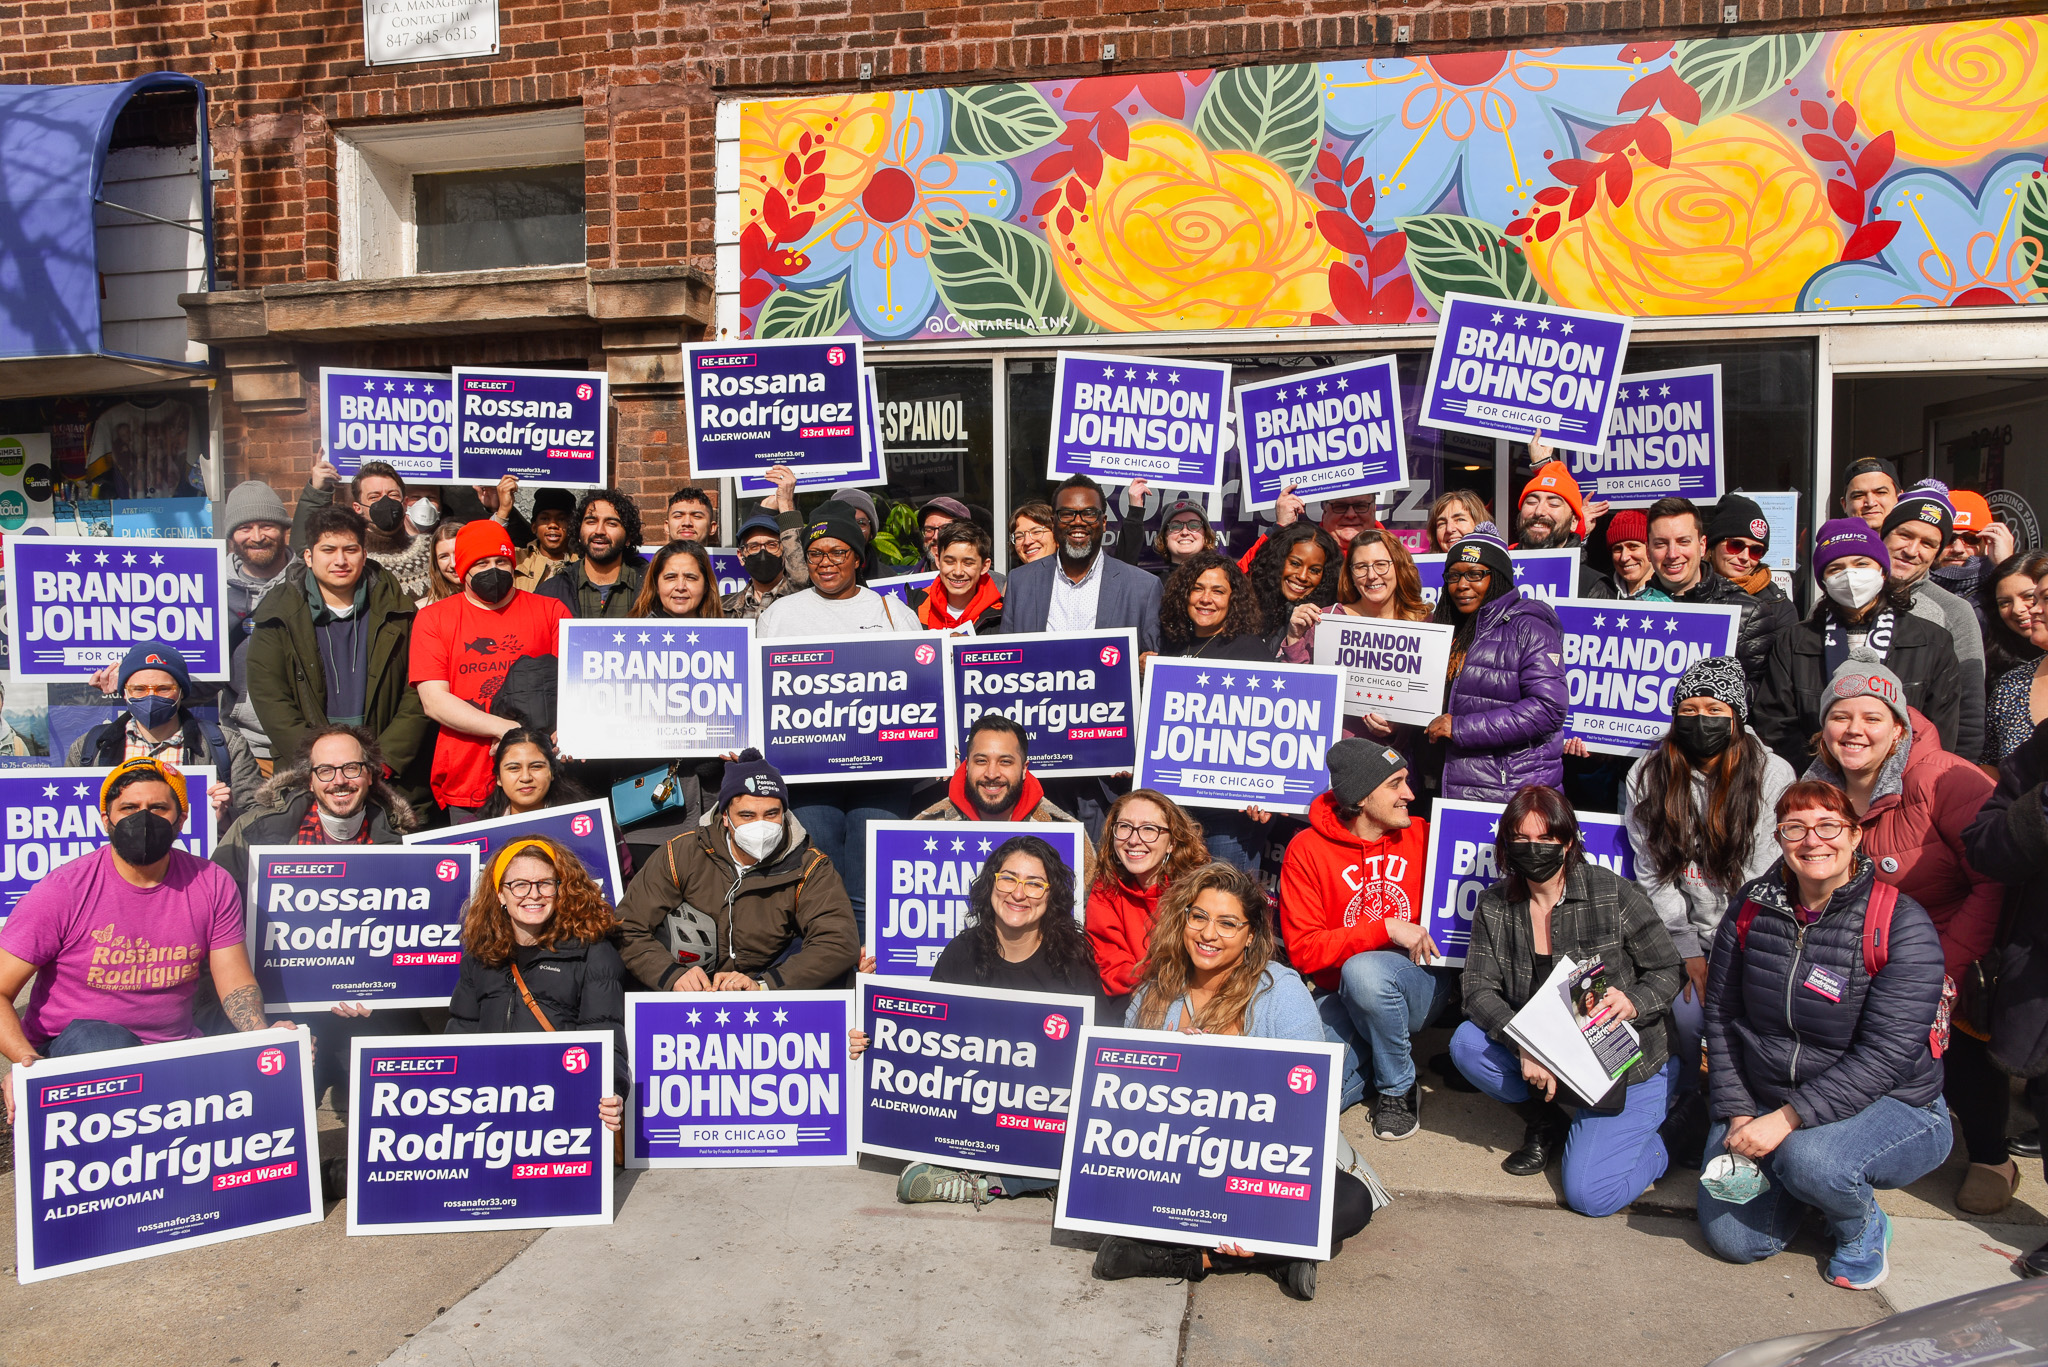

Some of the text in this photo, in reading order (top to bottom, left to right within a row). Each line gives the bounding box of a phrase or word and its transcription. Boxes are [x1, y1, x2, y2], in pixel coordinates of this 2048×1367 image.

[372, 2, 402, 14] L.C.A.
[392, 12, 470, 28] CONTACT JIM
[386, 26, 477, 48] 847-845-6315
[829, 352, 844, 364] 51
[1456, 326, 1605, 376] BRANDON
[702, 357, 748, 366] RE-ELECT
[467, 382, 507, 390] RE-ELECT
[577, 388, 591, 399] 51
[701, 372, 826, 397] Rossana
[1440, 358, 1605, 413] JOHNSON
[465, 394, 573, 419] Rossana
[1074, 382, 1210, 420] BRANDON
[701, 399, 852, 431] Rodríguez
[1255, 390, 1382, 439] BRANDON
[1477, 405, 1551, 425] FOR CHICAGO
[1608, 401, 1702, 435] ANDON
[334, 422, 452, 453] JOHNSO
[463, 422, 594, 451] Rodríguez
[702, 431, 770, 442] ALDERWOMAN
[802, 427, 850, 437] 33rd Ward
[1063, 413, 1214, 454] JOHNSON
[464, 447, 522, 456] ALDERWOMAN
[549, 450, 569, 458] 33rd
[1253, 420, 1392, 474] JOHNSON
[1100, 456, 1170, 469] FOR CHICAGO
[1290, 468, 1354, 485] FOR CHICAGO
[1607, 479, 1671, 489] FOR CHICAGO
[1919, 514, 1940, 524] SEIU
[1986, 494, 2038, 548] WORKING FAMIL
[122, 527, 213, 538] PLANES GENIALES
[1830, 533, 1853, 542] SEIU
[34, 571, 204, 603] BRANDON
[26, 606, 213, 641] JOHNSON
[1340, 630, 1420, 653] BRANDON
[774, 653, 823, 662] RE-ELECT
[916, 651, 933, 664] 51
[965, 652, 1013, 662] RE-ELECT
[1101, 652, 1118, 665] 51
[1335, 648, 1422, 674] JOHNSON
[1563, 634, 1712, 672] BRANDON
[583, 650, 734, 680] BRANDON
[771, 670, 907, 696] Rossana
[964, 669, 1095, 695] Rossana
[1350, 675, 1402, 688] FOR CHICAGO
[1868, 676, 1897, 703] CTU
[1567, 670, 1676, 715] OHNSO
[770, 699, 936, 734] Rodríguez
[1163, 691, 1321, 731] BRANDON
[881, 729, 933, 740] 33rd Ward
[1071, 729, 1122, 738] 33rd Ward
[1584, 718, 1660, 736] FOR CHICAGO
[772, 733, 846, 744] ALDERWOMAN
[1150, 725, 1326, 771] JOHNSON
[828, 755, 883, 763] rossanafor33.org
[1026, 754, 1073, 762] ssanafor33.org
[1193, 774, 1274, 788] FOR CHICAGO
[574, 820, 592, 834] 51
[274, 864, 334, 874] RE-ELECT
[437, 866, 457, 880] 51
[892, 860, 984, 895] BRAN
[1342, 854, 1408, 891] CTU
[268, 883, 430, 912] Rossana
[1346, 896, 1360, 927] CHICAGO
[264, 918, 461, 956] Rodríguez
[92, 946, 187, 964] Rossana
[264, 956, 354, 968] ALDERWOMAN
[396, 953, 456, 964] 33rd Ward
[87, 982, 141, 990] ALDERWOMAN
[332, 980, 396, 990] rossanafor33.org
[878, 999, 936, 1015] RE-ELECT
[1052, 1015, 1067, 1024] PUNCH
[1045, 1020, 1067, 1038] 51
[653, 1032, 830, 1070] BRANDON
[874, 1017, 1037, 1068] Rossana
[261, 1056, 282, 1072] 51
[377, 1060, 444, 1071] RE-ELECT
[565, 1054, 586, 1071] 51
[1101, 1052, 1167, 1066] RE-ELECT
[48, 1079, 128, 1102] RE-ELECT
[871, 1058, 1072, 1115] Rodríguez
[1289, 1073, 1312, 1091] 51
[371, 1082, 555, 1117] Rossana
[643, 1073, 839, 1117] JOHNSON
[1091, 1072, 1276, 1123] Rossana
[871, 1098, 957, 1119] ALDERWOMAN
[44, 1090, 252, 1151] Rossana
[1000, 1116, 1066, 1131] 33rd Ward
[694, 1130, 786, 1140] FOR CHICAGO
[934, 1136, 1000, 1151] rossanafor33.org
[367, 1122, 592, 1169] Rodríguez
[1082, 1118, 1313, 1178] Rodríguez
[42, 1128, 295, 1200] Rodríguez
[516, 1164, 586, 1176] 33rd Ward
[217, 1164, 292, 1188] 33rd Ward
[367, 1168, 469, 1182] ALDERWOMAN
[1080, 1163, 1181, 1184] ALDERWOMAN
[1229, 1179, 1304, 1197] 33rd Ward
[44, 1188, 164, 1222] ALDERWOMAN
[444, 1198, 517, 1208] rossanafor33.org
[138, 1210, 220, 1233] rossanafor33.org
[1152, 1206, 1227, 1222] rossanafor33.org
